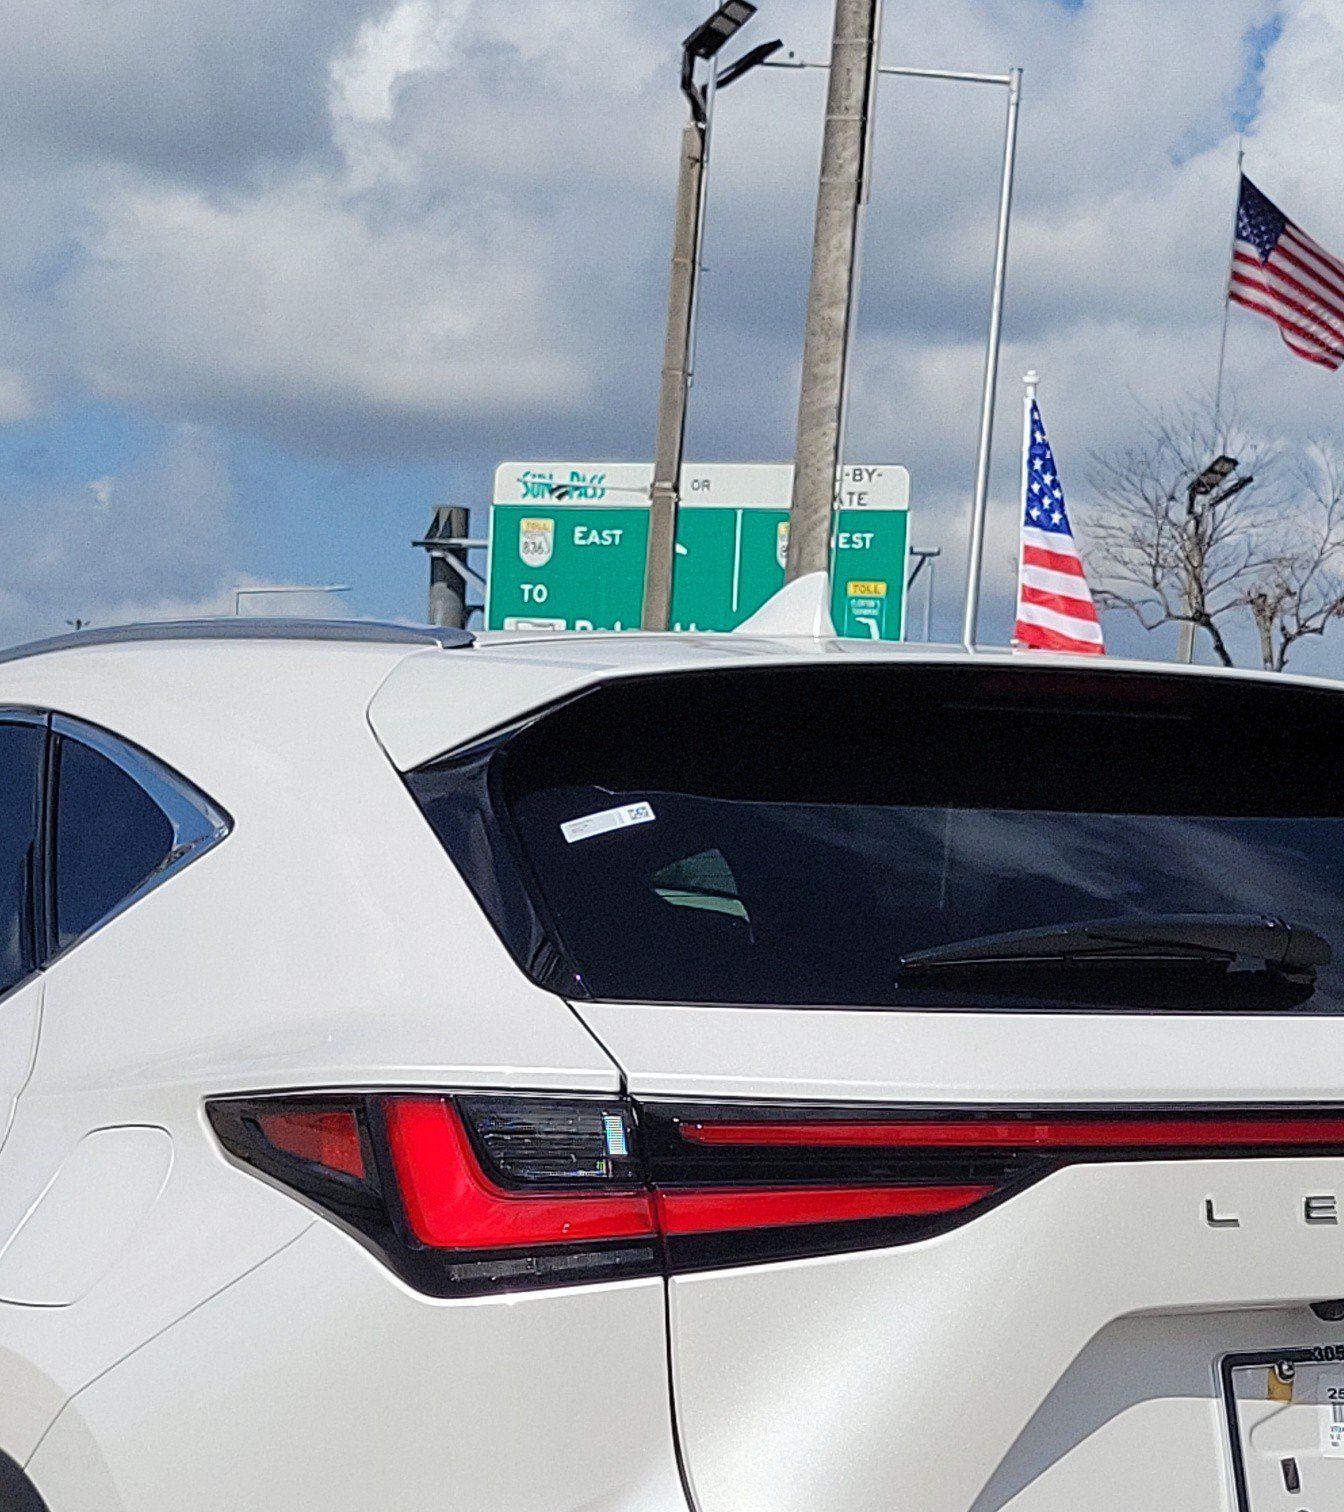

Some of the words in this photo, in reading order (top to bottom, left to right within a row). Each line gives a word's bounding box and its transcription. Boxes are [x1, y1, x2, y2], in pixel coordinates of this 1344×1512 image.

[691, 479, 711, 492] OR
[573, 526, 623, 546] EAST
[831, 532, 875, 549] EST
[520, 584, 548, 603] TO
[852, 583, 882, 595] TOLL
